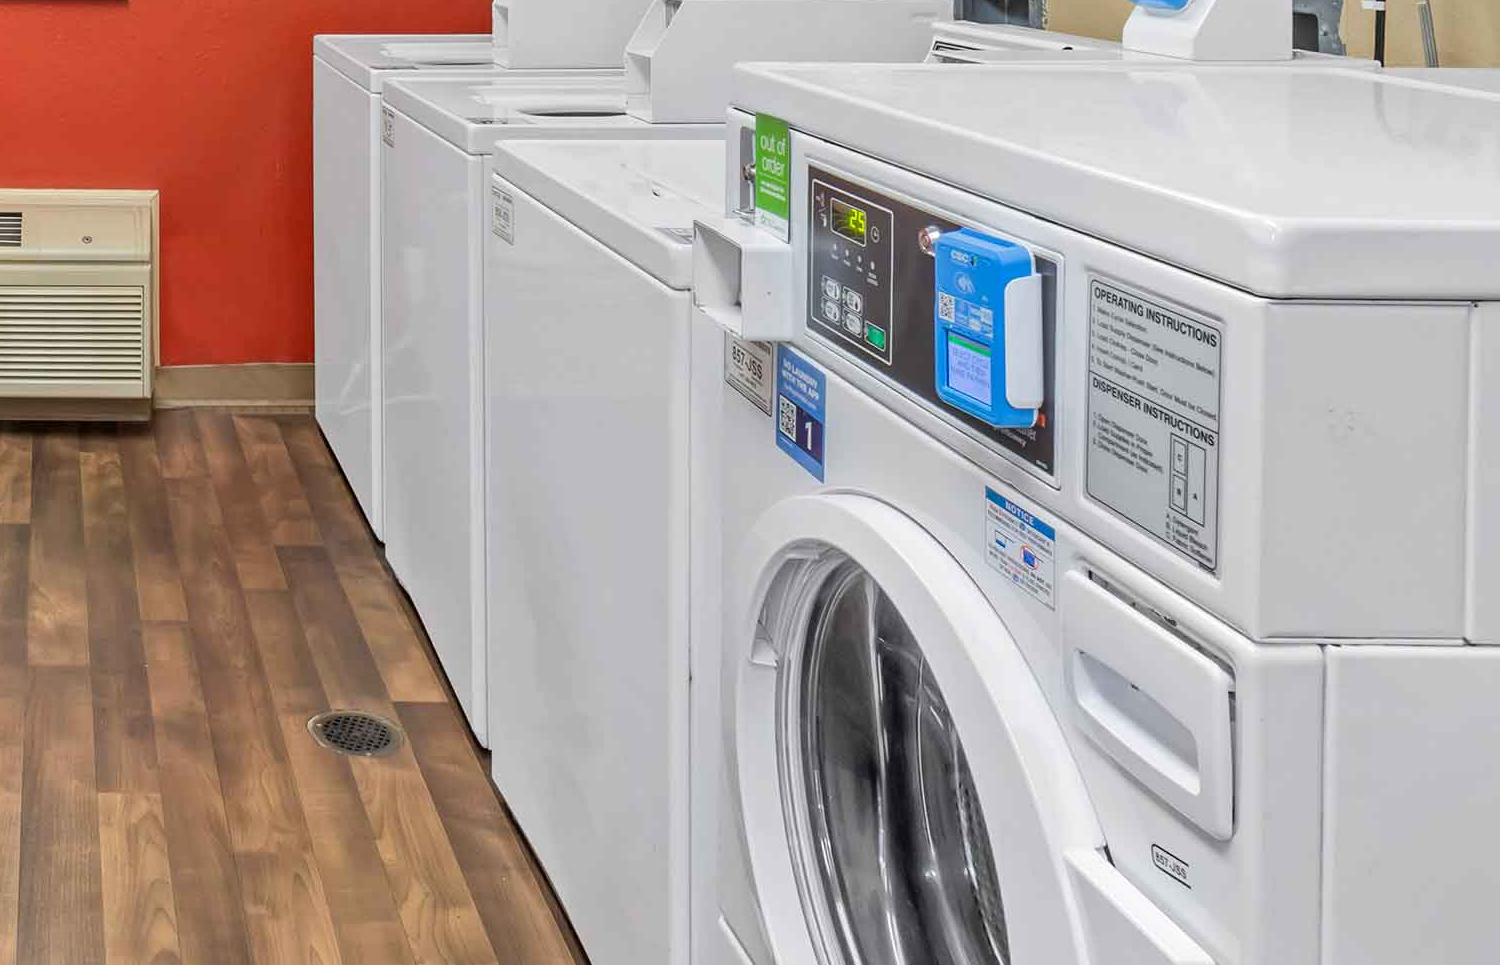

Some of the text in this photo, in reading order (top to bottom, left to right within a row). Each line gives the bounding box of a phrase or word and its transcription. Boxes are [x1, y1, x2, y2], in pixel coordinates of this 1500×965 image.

[849, 207, 865, 233] 25
[1094, 286, 1144, 317] OPERATING
[1145, 307, 1218, 348] INSTRUCTIONS
[731, 345, 763, 380] 857-JSS
[1092, 377, 1141, 410] DISPENSER
[1143, 404, 1215, 447] INSTRUCTIONS
[804, 420, 813, 451] 1
[1004, 499, 1035, 527] NOTICE
